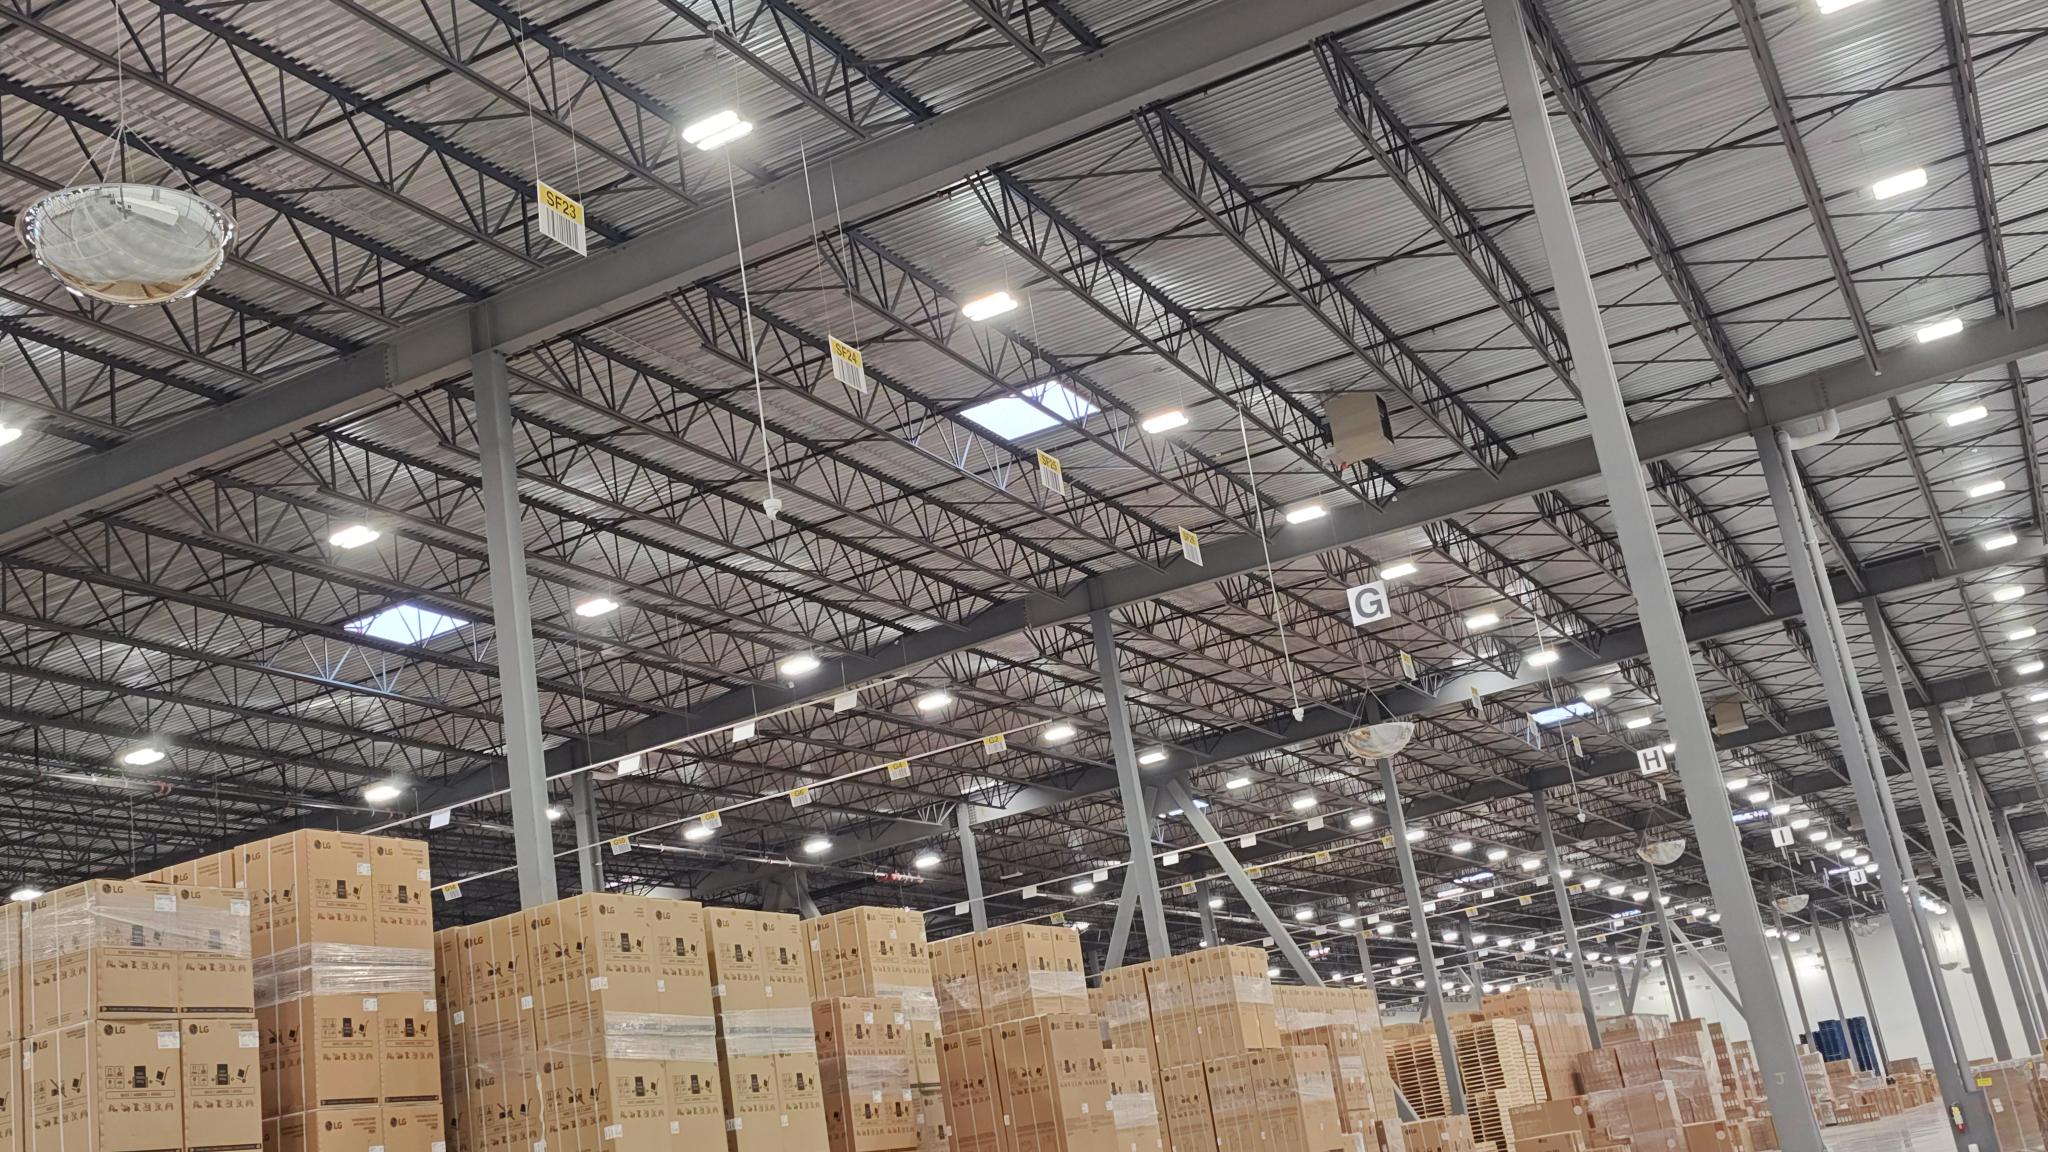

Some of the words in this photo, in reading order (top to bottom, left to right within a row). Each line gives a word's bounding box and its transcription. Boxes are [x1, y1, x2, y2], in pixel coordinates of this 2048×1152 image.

[546, 190, 577, 220] SF23
[836, 345, 857, 366] SF24
[1042, 455, 1059, 474] SF25
[1354, 587, 1384, 617] G
[989, 736, 999, 744] G2
[1642, 749, 1661, 770] H
[1780, 830, 1785, 843] I
[252, 853, 260, 861] LG
[180, 873, 188, 881] LG
[1854, 871, 1862, 883] J
[191, 891, 200, 899] LG
[663, 912, 671, 920] LG
[541, 917, 550, 926] LG
[474, 937, 483, 945] LG
[115, 1026, 125, 1034] LG
[38, 1040, 48, 1049] LG
[554, 1061, 564, 1070] LG
[485, 1077, 495, 1086] LG
[334, 1122, 342, 1130] LG
[398, 1118, 406, 1126] LG
